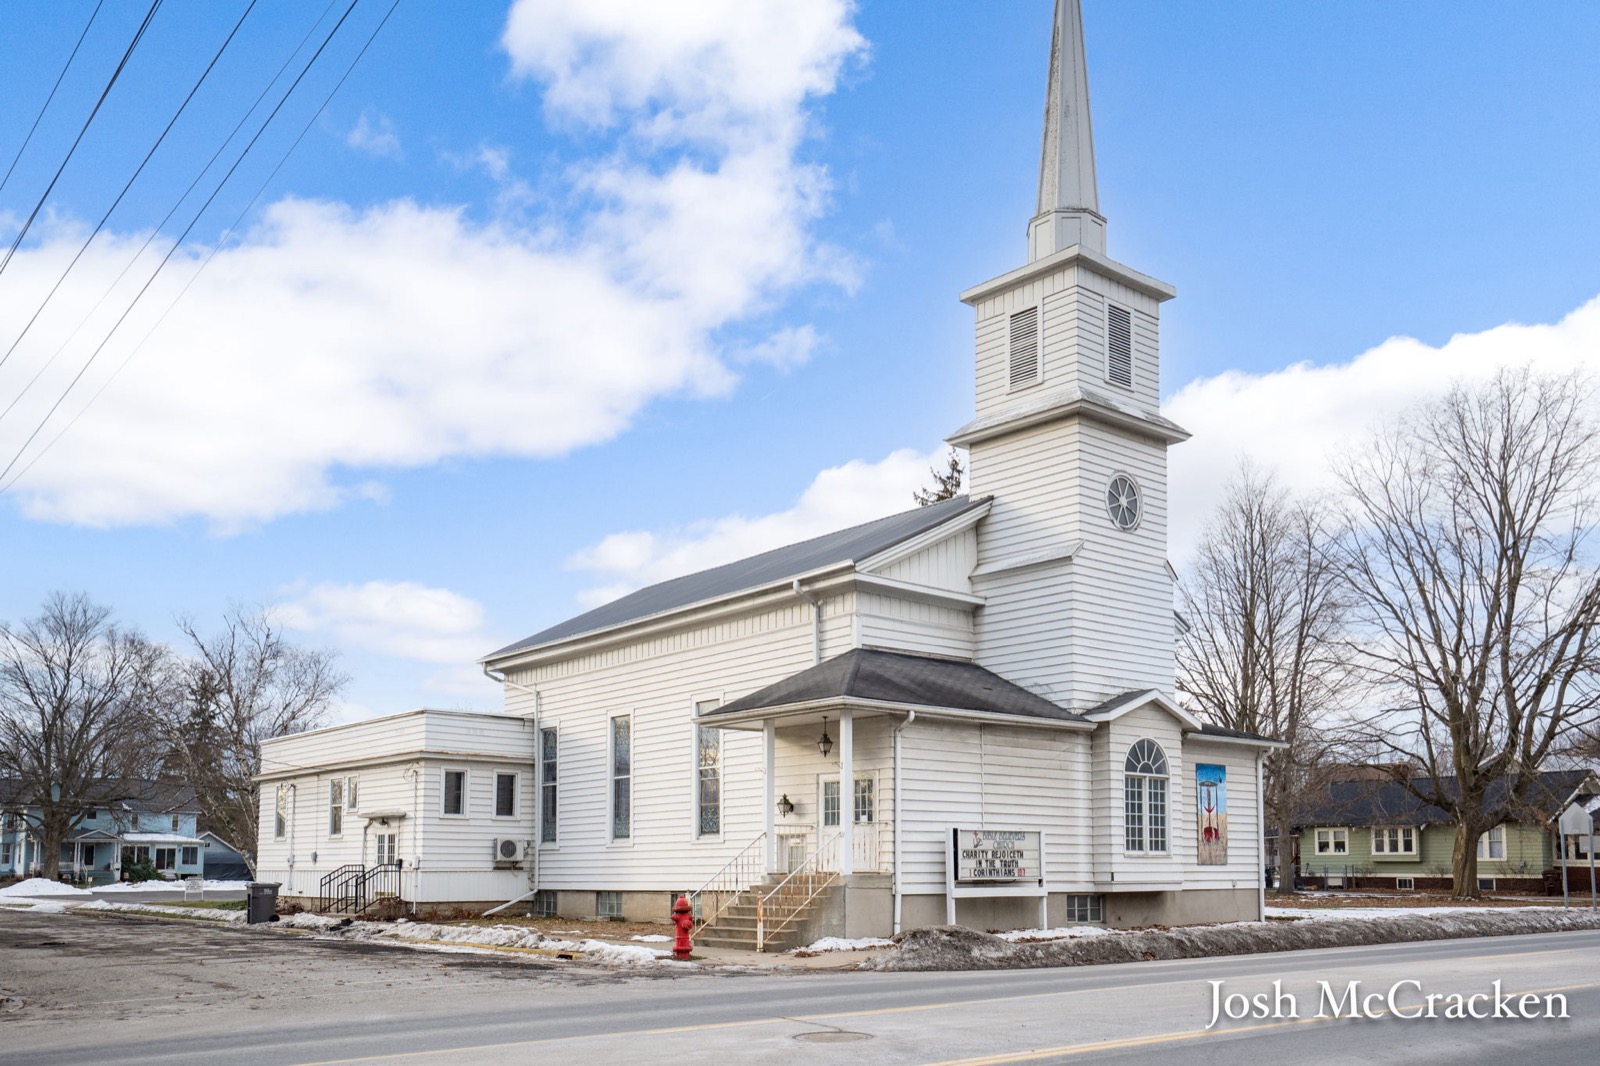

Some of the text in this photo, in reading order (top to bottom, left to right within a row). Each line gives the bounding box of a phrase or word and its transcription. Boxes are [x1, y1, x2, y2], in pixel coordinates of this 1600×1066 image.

[962, 850, 1024, 859] CHARITY REJOICETH
[975, 860, 1019, 868] IN THE TRUTH
[973, 868, 1015, 877] CORINTHIANS
